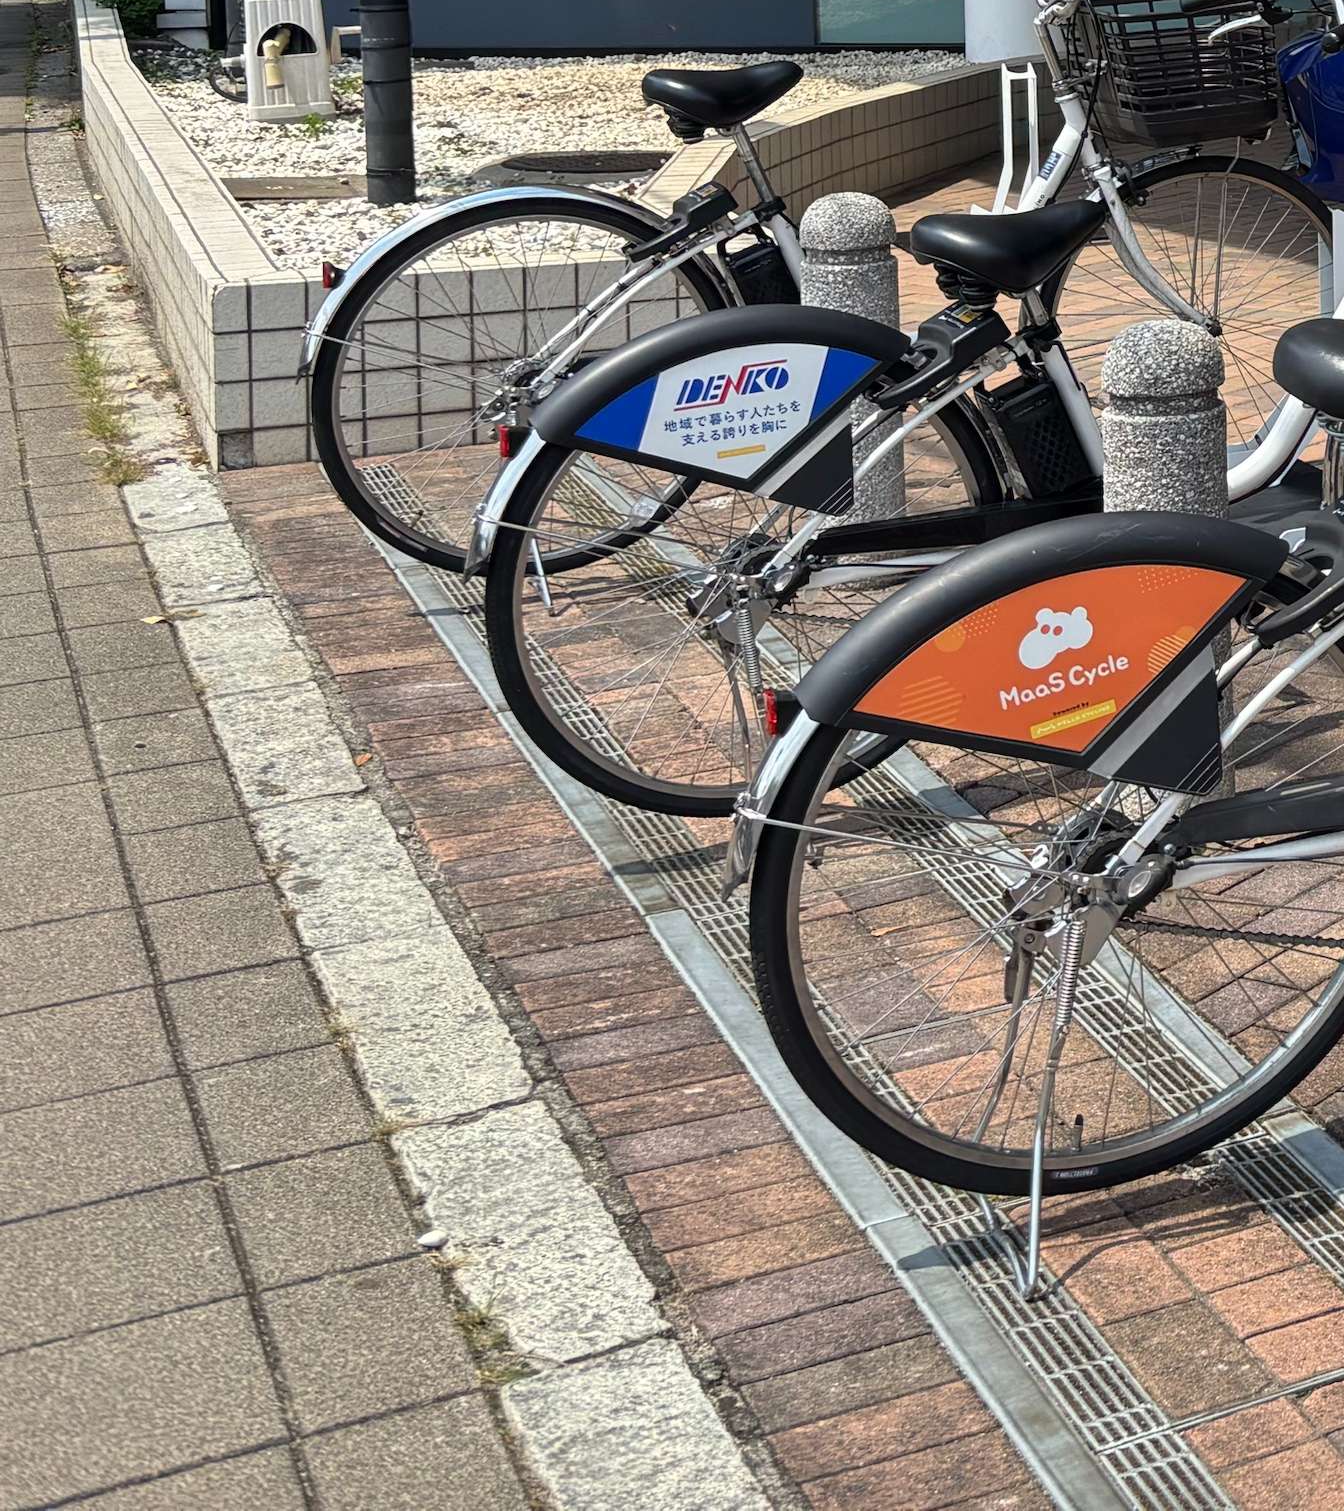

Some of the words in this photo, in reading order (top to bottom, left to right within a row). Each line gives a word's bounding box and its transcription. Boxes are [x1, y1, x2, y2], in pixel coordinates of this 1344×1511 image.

[675, 360, 789, 410] DENKO
[664, 400, 801, 433] 地域で暮らす人たちを
[682, 420, 787, 446] 支える誇りを胸に
[999, 672, 1066, 710] MaaS
[1068, 654, 1129, 686] Cycle
